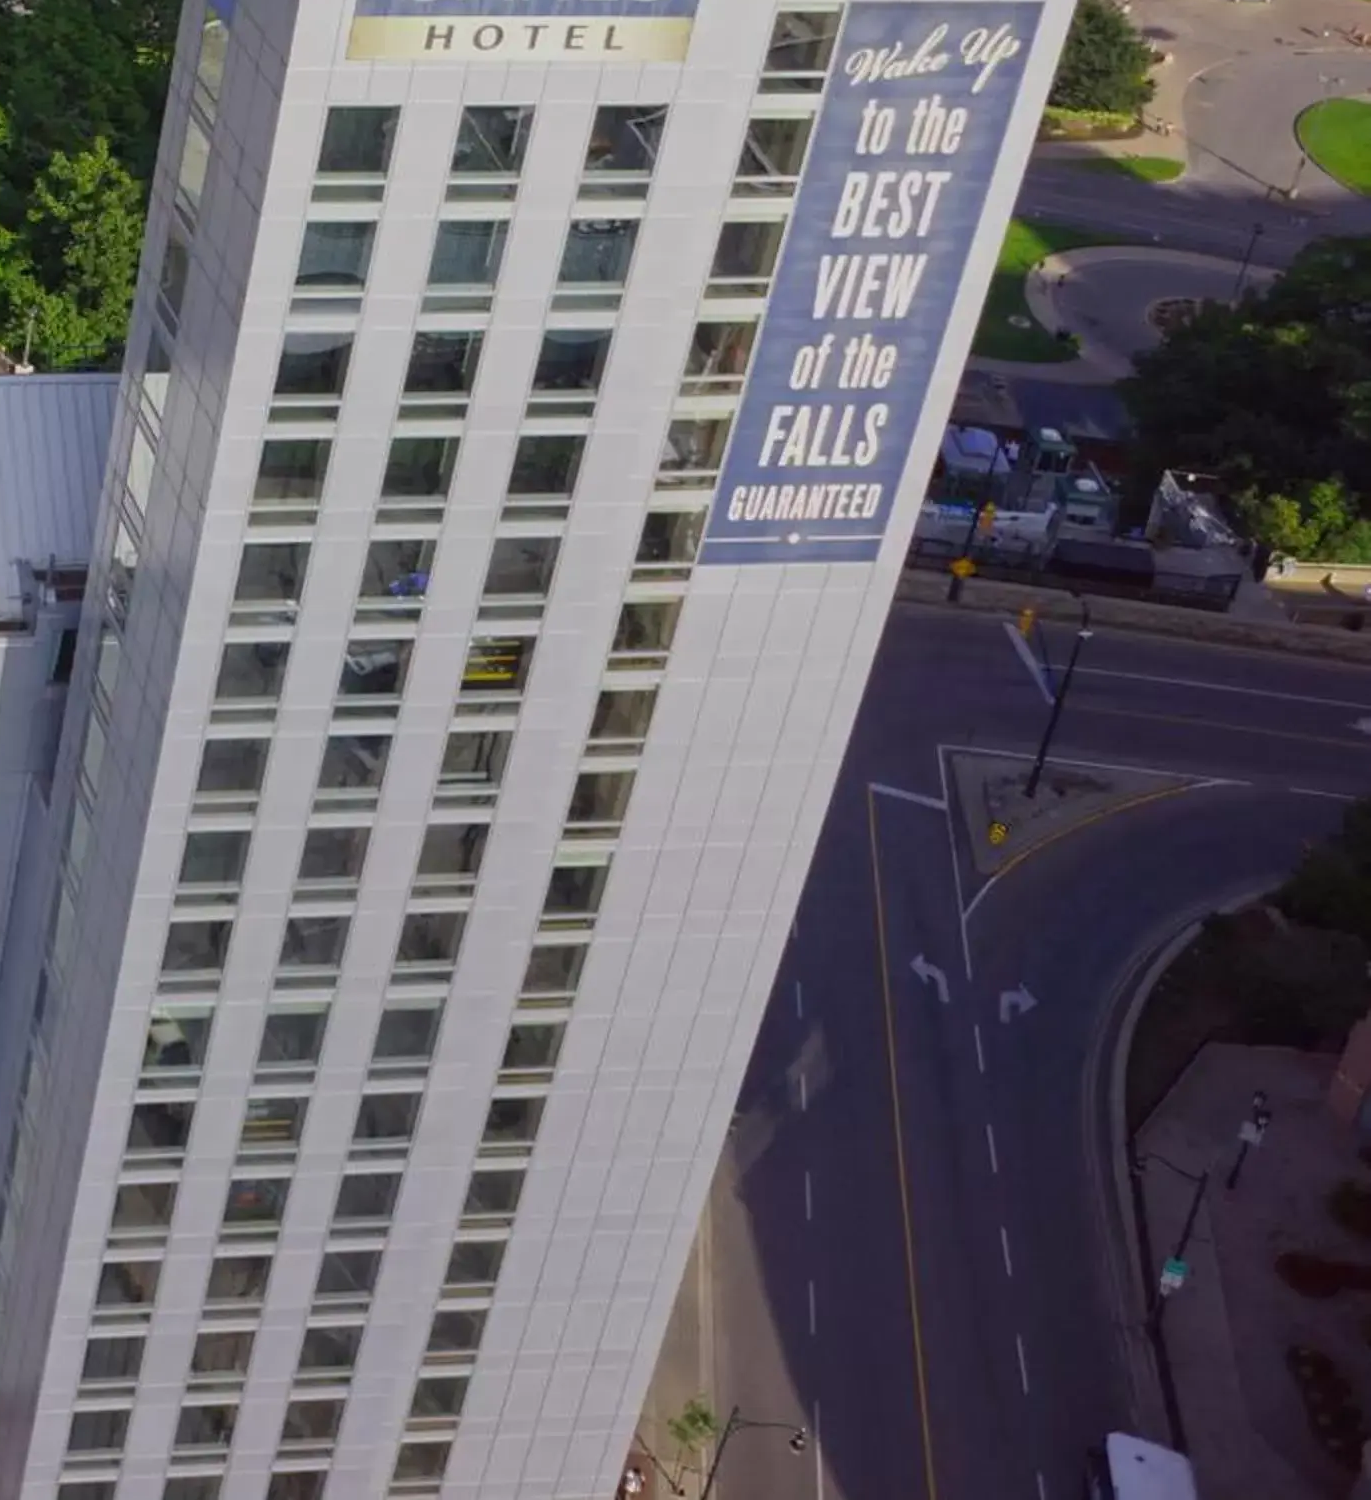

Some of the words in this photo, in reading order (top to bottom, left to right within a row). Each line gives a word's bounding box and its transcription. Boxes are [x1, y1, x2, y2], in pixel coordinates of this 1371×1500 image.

[424, 24, 626, 51] HOTEL
[844, 24, 954, 86] Wake
[960, 24, 1021, 94] Up
[855, 98, 896, 155] to
[905, 94, 968, 155] the
[831, 171, 952, 239] BEST
[812, 253, 928, 320] VIEW
[789, 333, 835, 391] of
[838, 333, 898, 390] the
[758, 403, 889, 468] FALLS
[727, 483, 883, 522] GUARANTEED
